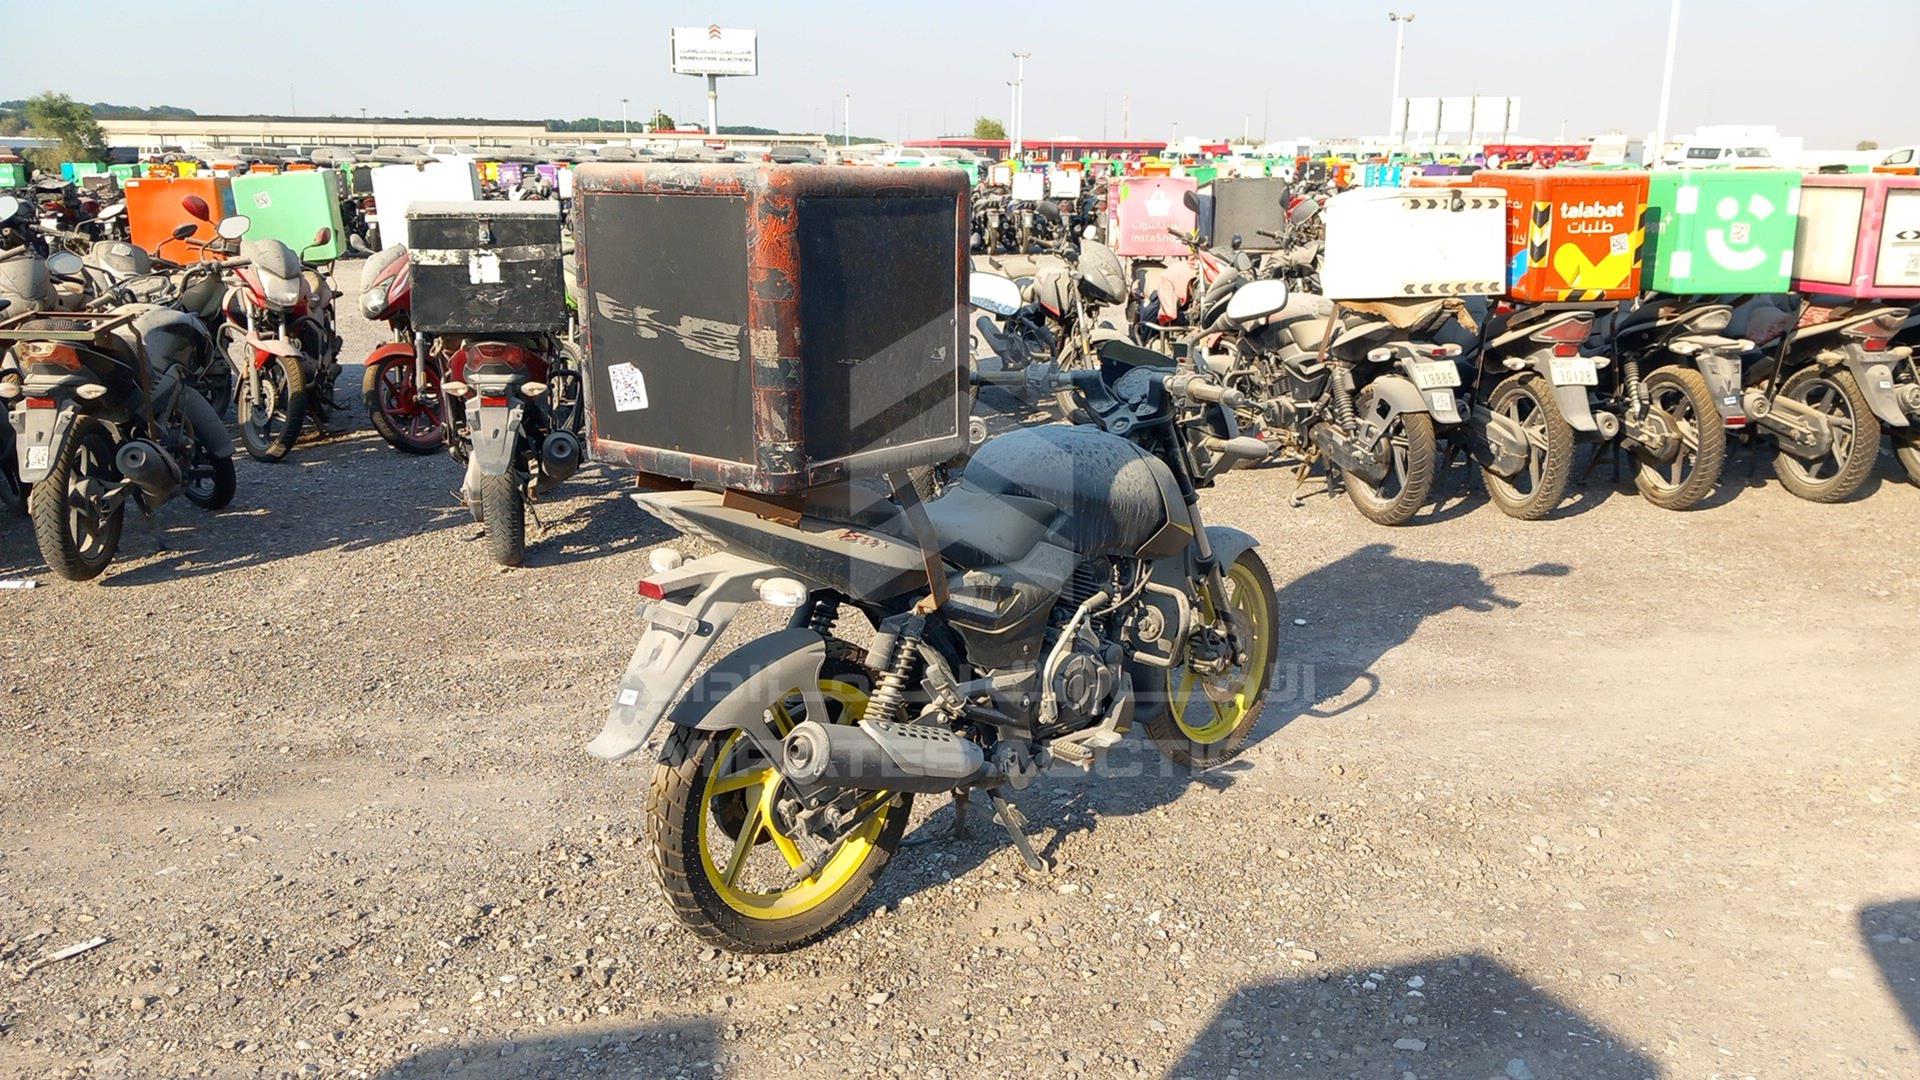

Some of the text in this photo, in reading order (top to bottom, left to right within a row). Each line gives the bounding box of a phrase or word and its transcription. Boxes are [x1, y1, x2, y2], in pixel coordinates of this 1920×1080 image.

[1560, 200, 1625, 219] talabat
[1566, 220, 1615, 237] طلبات
[1423, 372, 1455, 385] 19886
